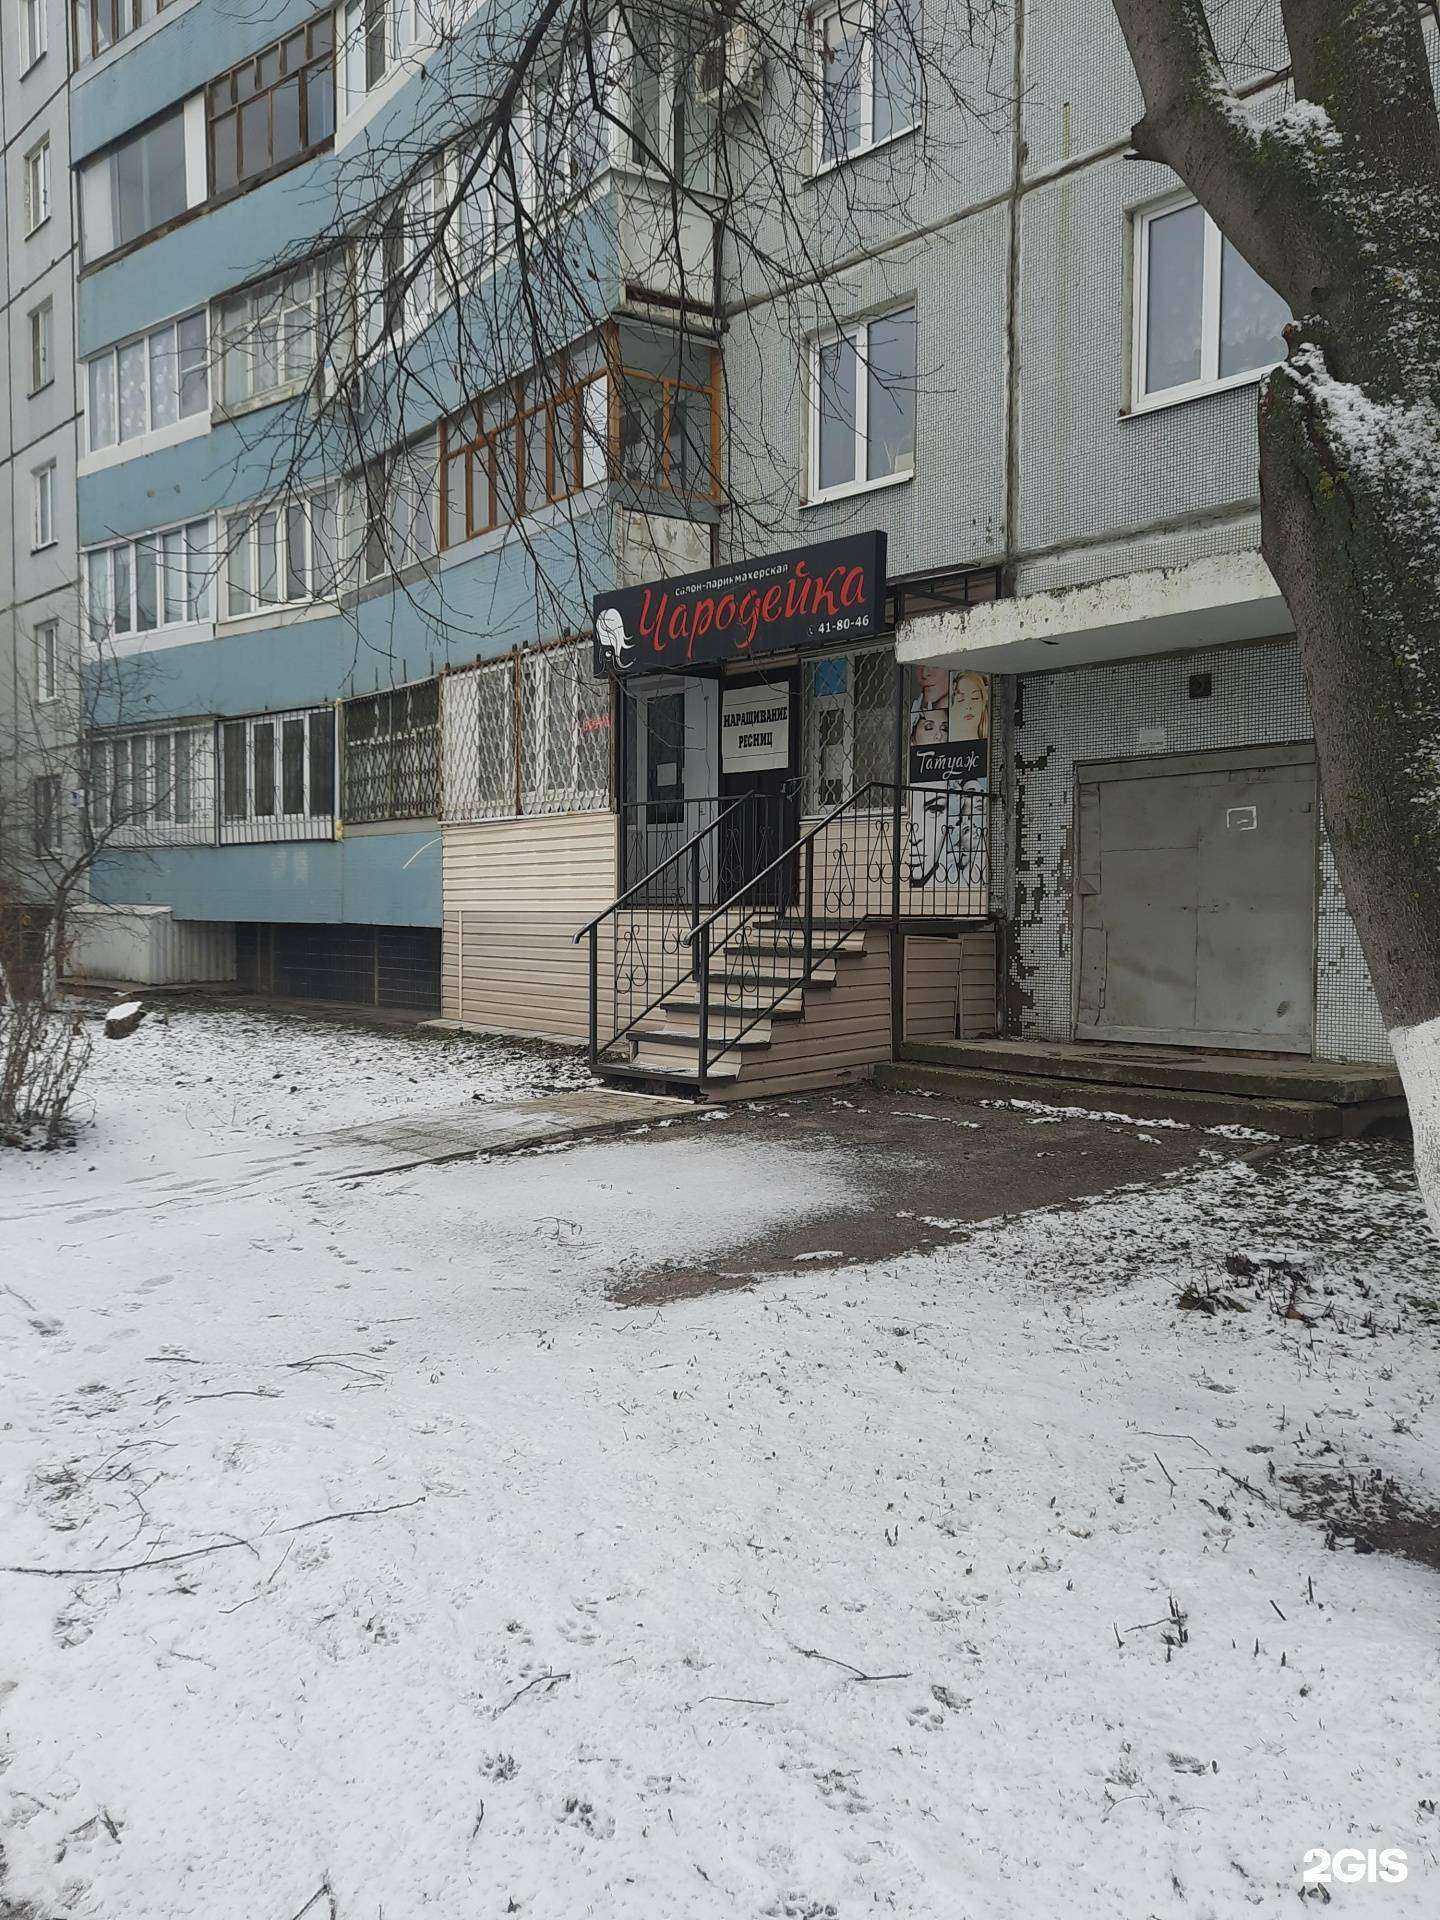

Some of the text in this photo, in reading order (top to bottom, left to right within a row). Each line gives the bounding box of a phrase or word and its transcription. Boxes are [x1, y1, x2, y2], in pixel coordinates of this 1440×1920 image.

[639, 560, 866, 662] Чародейка
[818, 614, 869, 634] 41-80-46
[723, 706, 788, 728] НАРАЩИВАНИЕ
[738, 732, 773, 749] РЕСНИЦ
[916, 750, 980, 780] Татуаж
